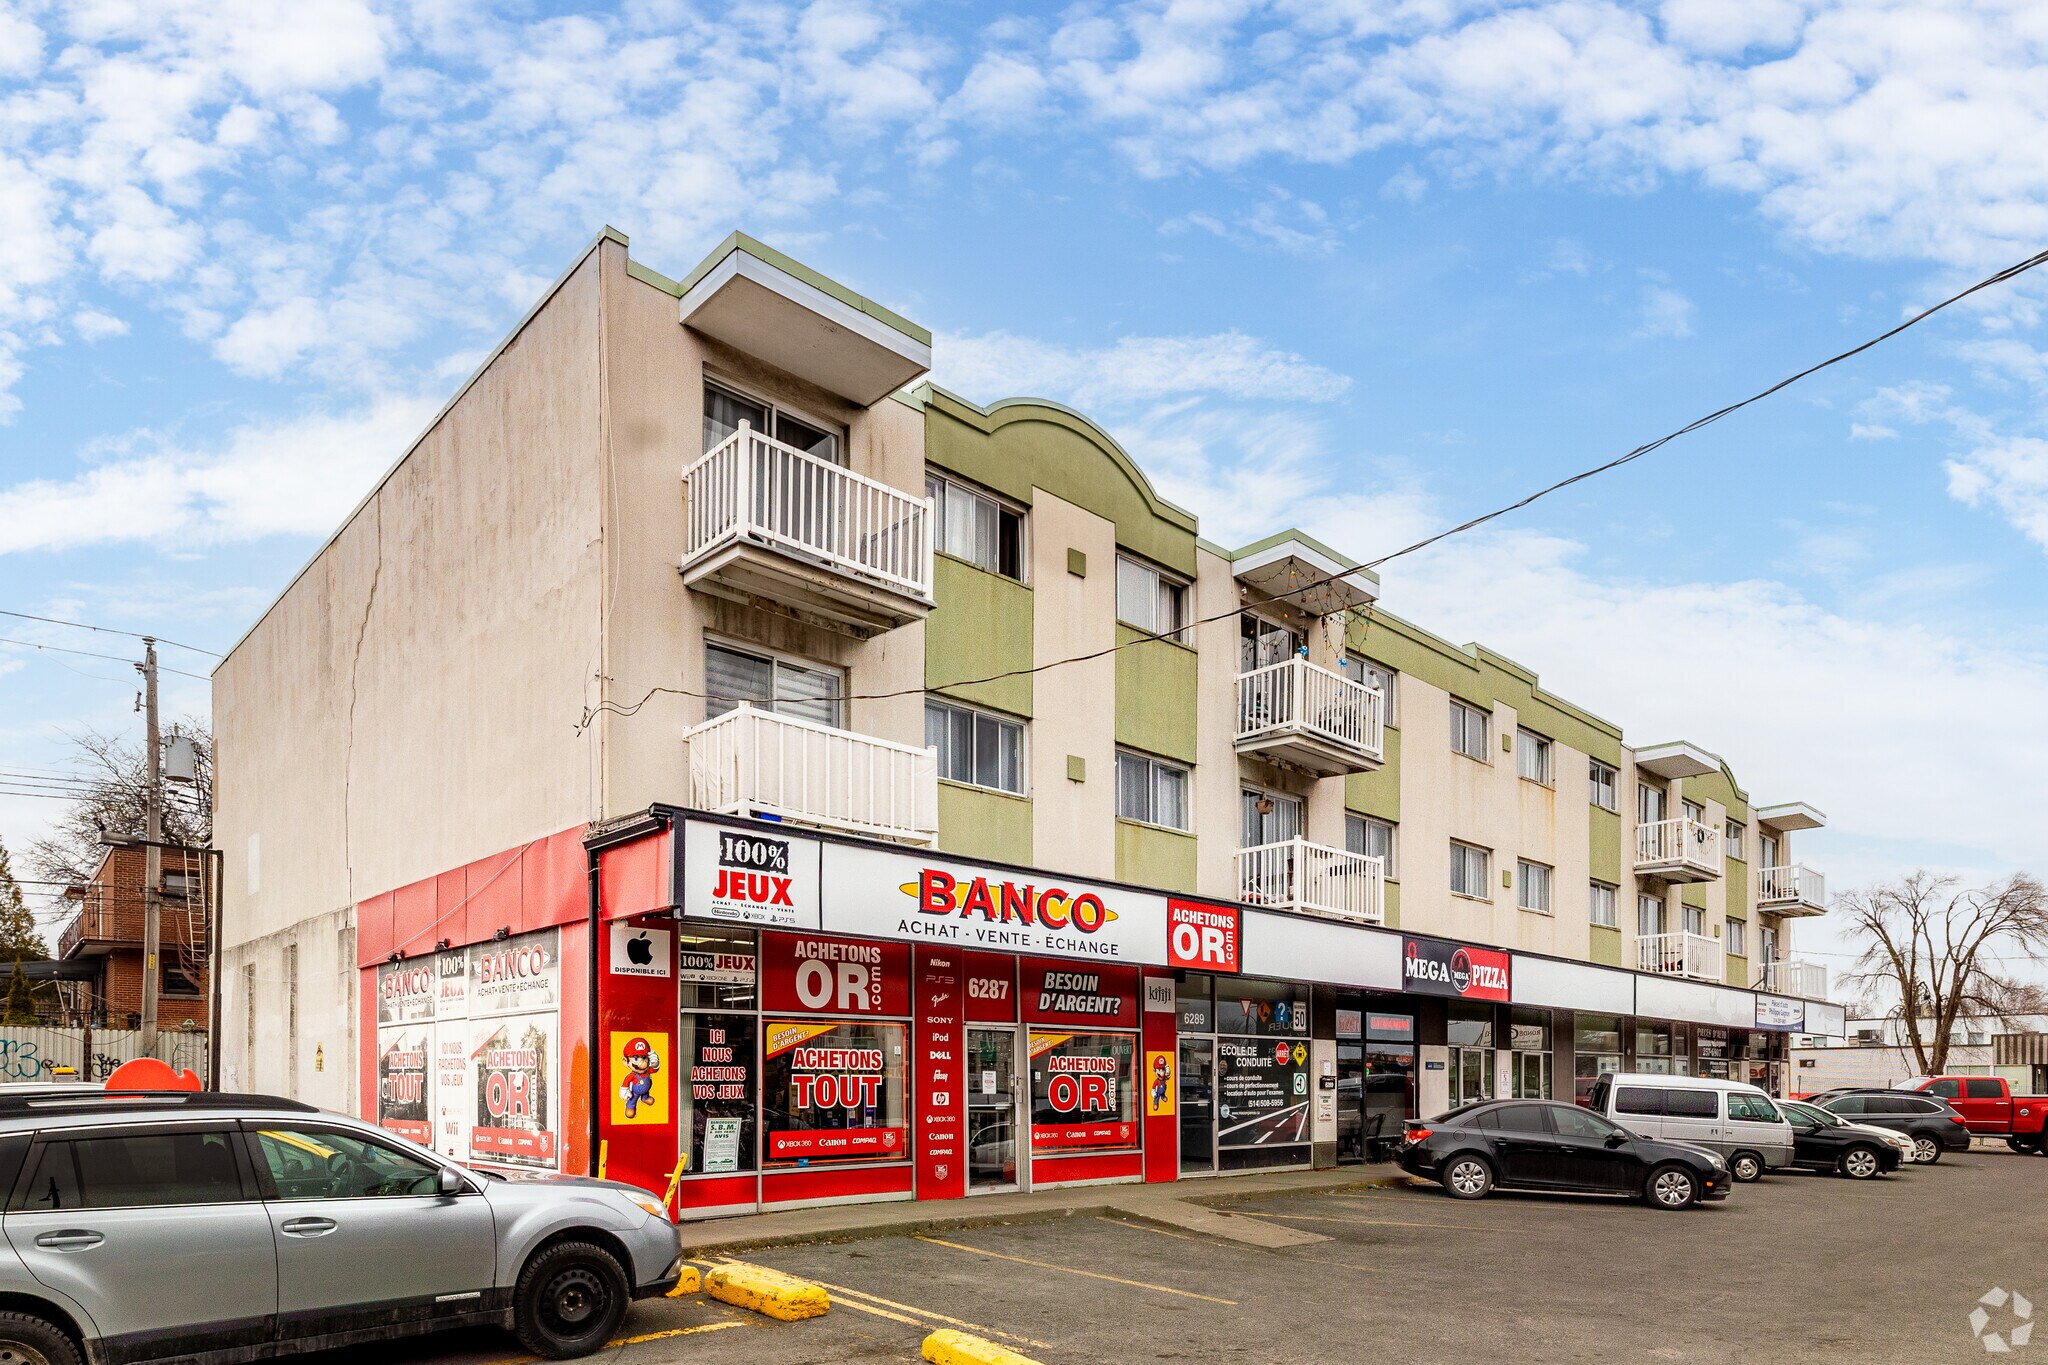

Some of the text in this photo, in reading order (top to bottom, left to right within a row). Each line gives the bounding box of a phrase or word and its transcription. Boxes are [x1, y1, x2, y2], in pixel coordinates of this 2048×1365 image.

[725, 838, 786, 869] 100%
[712, 869, 794, 907] JEUX
[918, 868, 1106, 935] BANCO
[751, 912, 766, 920] XBOX
[1173, 908, 1234, 927] ACHETONS
[898, 919, 959, 939] ACHAT
[976, 929, 1030, 946] VENTE
[1045, 934, 1119, 956] ÉCHANGE
[1172, 924, 1224, 963] OR
[794, 940, 881, 964] ACHETONS
[1226, 932, 1234, 964] .com
[440, 955, 465, 976] 100%
[480, 943, 545, 984] BANCO
[614, 966, 655, 975] DISPONIBLE
[682, 955, 713, 968] 100%
[716, 955, 755, 970] JEUX
[930, 958, 951, 967] Nikon
[1405, 956, 1450, 983] MEGA
[385, 965, 431, 999] BANCO
[497, 983, 517, 994] VENTE
[519, 978, 549, 992] ECHANGE
[795, 959, 870, 1010] OR
[926, 974, 954, 984] PS3
[1044, 972, 1099, 991] BESOIN
[1471, 964, 1508, 990] PIZZA
[871, 966, 881, 1010] .com
[968, 977, 1009, 999] 6287
[1148, 985, 1171, 1004] kijiji
[1038, 993, 1121, 1014] D'ARGENT?
[926, 1016, 953, 1024] SONY
[1184, 1013, 1205, 1025] 6289
[1294, 1011, 1305, 1027] 50
[709, 1029, 725, 1044] ICI
[772, 1026, 797, 1042] BESOIN
[772, 1030, 809, 1050] D'ARGENT?
[932, 1032, 949, 1042] iPod
[388, 1050, 424, 1069] ACHETONS
[486, 1049, 536, 1069] ACHETONS
[702, 1047, 732, 1062] NOUS
[791, 1047, 883, 1070] ACHETONS
[929, 1050, 951, 1060] DELL
[1221, 1044, 1257, 1056] ÉCOLE DE
[1047, 1056, 1116, 1073] ACHETONS
[1236, 1057, 1272, 1067] CONDUITE
[691, 1066, 746, 1081] ACHETONS
[388, 1072, 424, 1102] TOUT
[486, 1070, 530, 1118] OR
[693, 1084, 744, 1100] VOS JEUX
[791, 1073, 882, 1108] TOUT
[1048, 1074, 1109, 1113] OR
[445, 1121, 459, 1136] Wii
[818, 1138, 847, 1147] Canon
